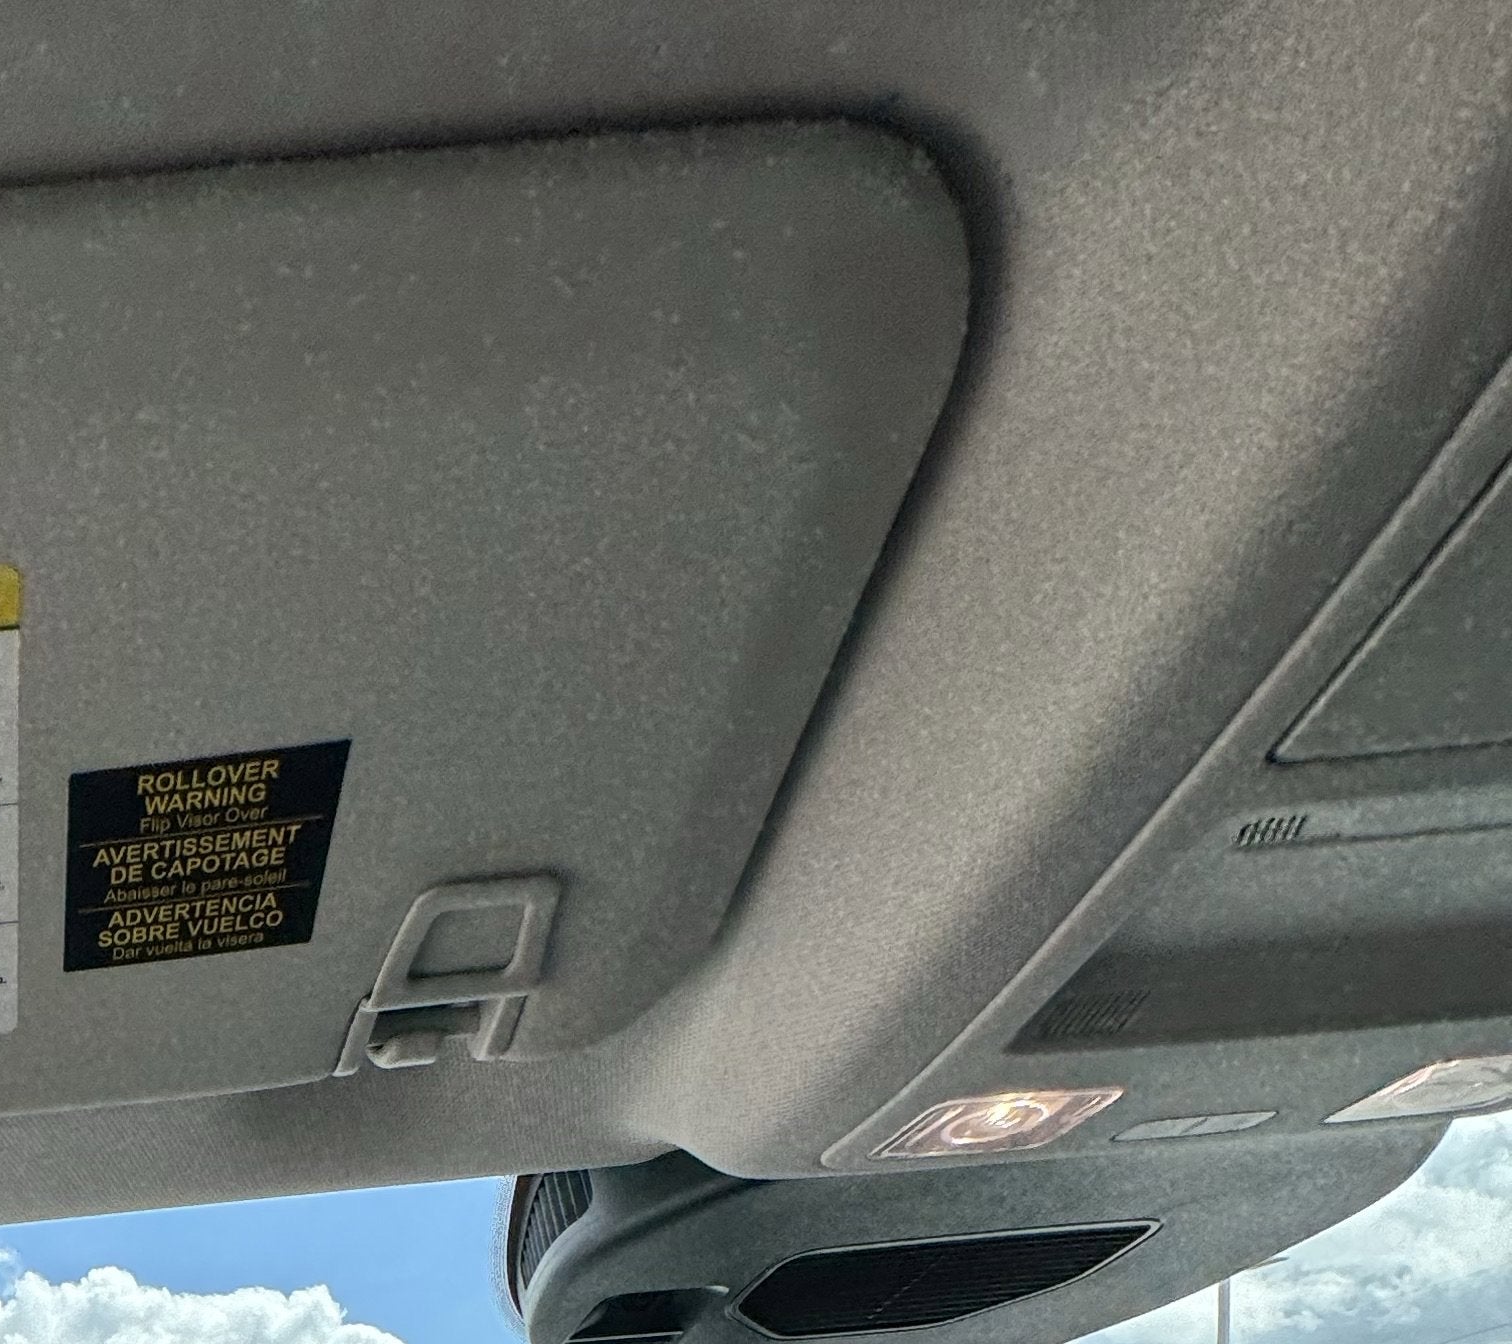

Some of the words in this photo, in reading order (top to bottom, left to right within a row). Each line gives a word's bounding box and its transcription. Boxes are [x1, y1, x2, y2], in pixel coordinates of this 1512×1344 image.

[137, 758, 281, 795] ROLLOVER
[144, 782, 267, 815] WARNING
[139, 816, 171, 835] Flip
[176, 810, 219, 828] Visor
[225, 803, 268, 822] Over
[93, 824, 300, 867] AVERTISSEMENT
[110, 864, 143, 884] DE
[150, 846, 286, 880] CAPOTAGE
[104, 882, 176, 903] Abaisser
[182, 880, 195, 893] le
[200, 869, 286, 894] pare-soleil
[108, 891, 278, 928] ADVERTENCIA
[98, 922, 179, 948] SOBRE
[187, 909, 283, 937] VUELCO
[112, 945, 139, 960] Dar
[145, 939, 192, 956] vuelta
[198, 936, 211, 949] la
[217, 930, 264, 947] visera
